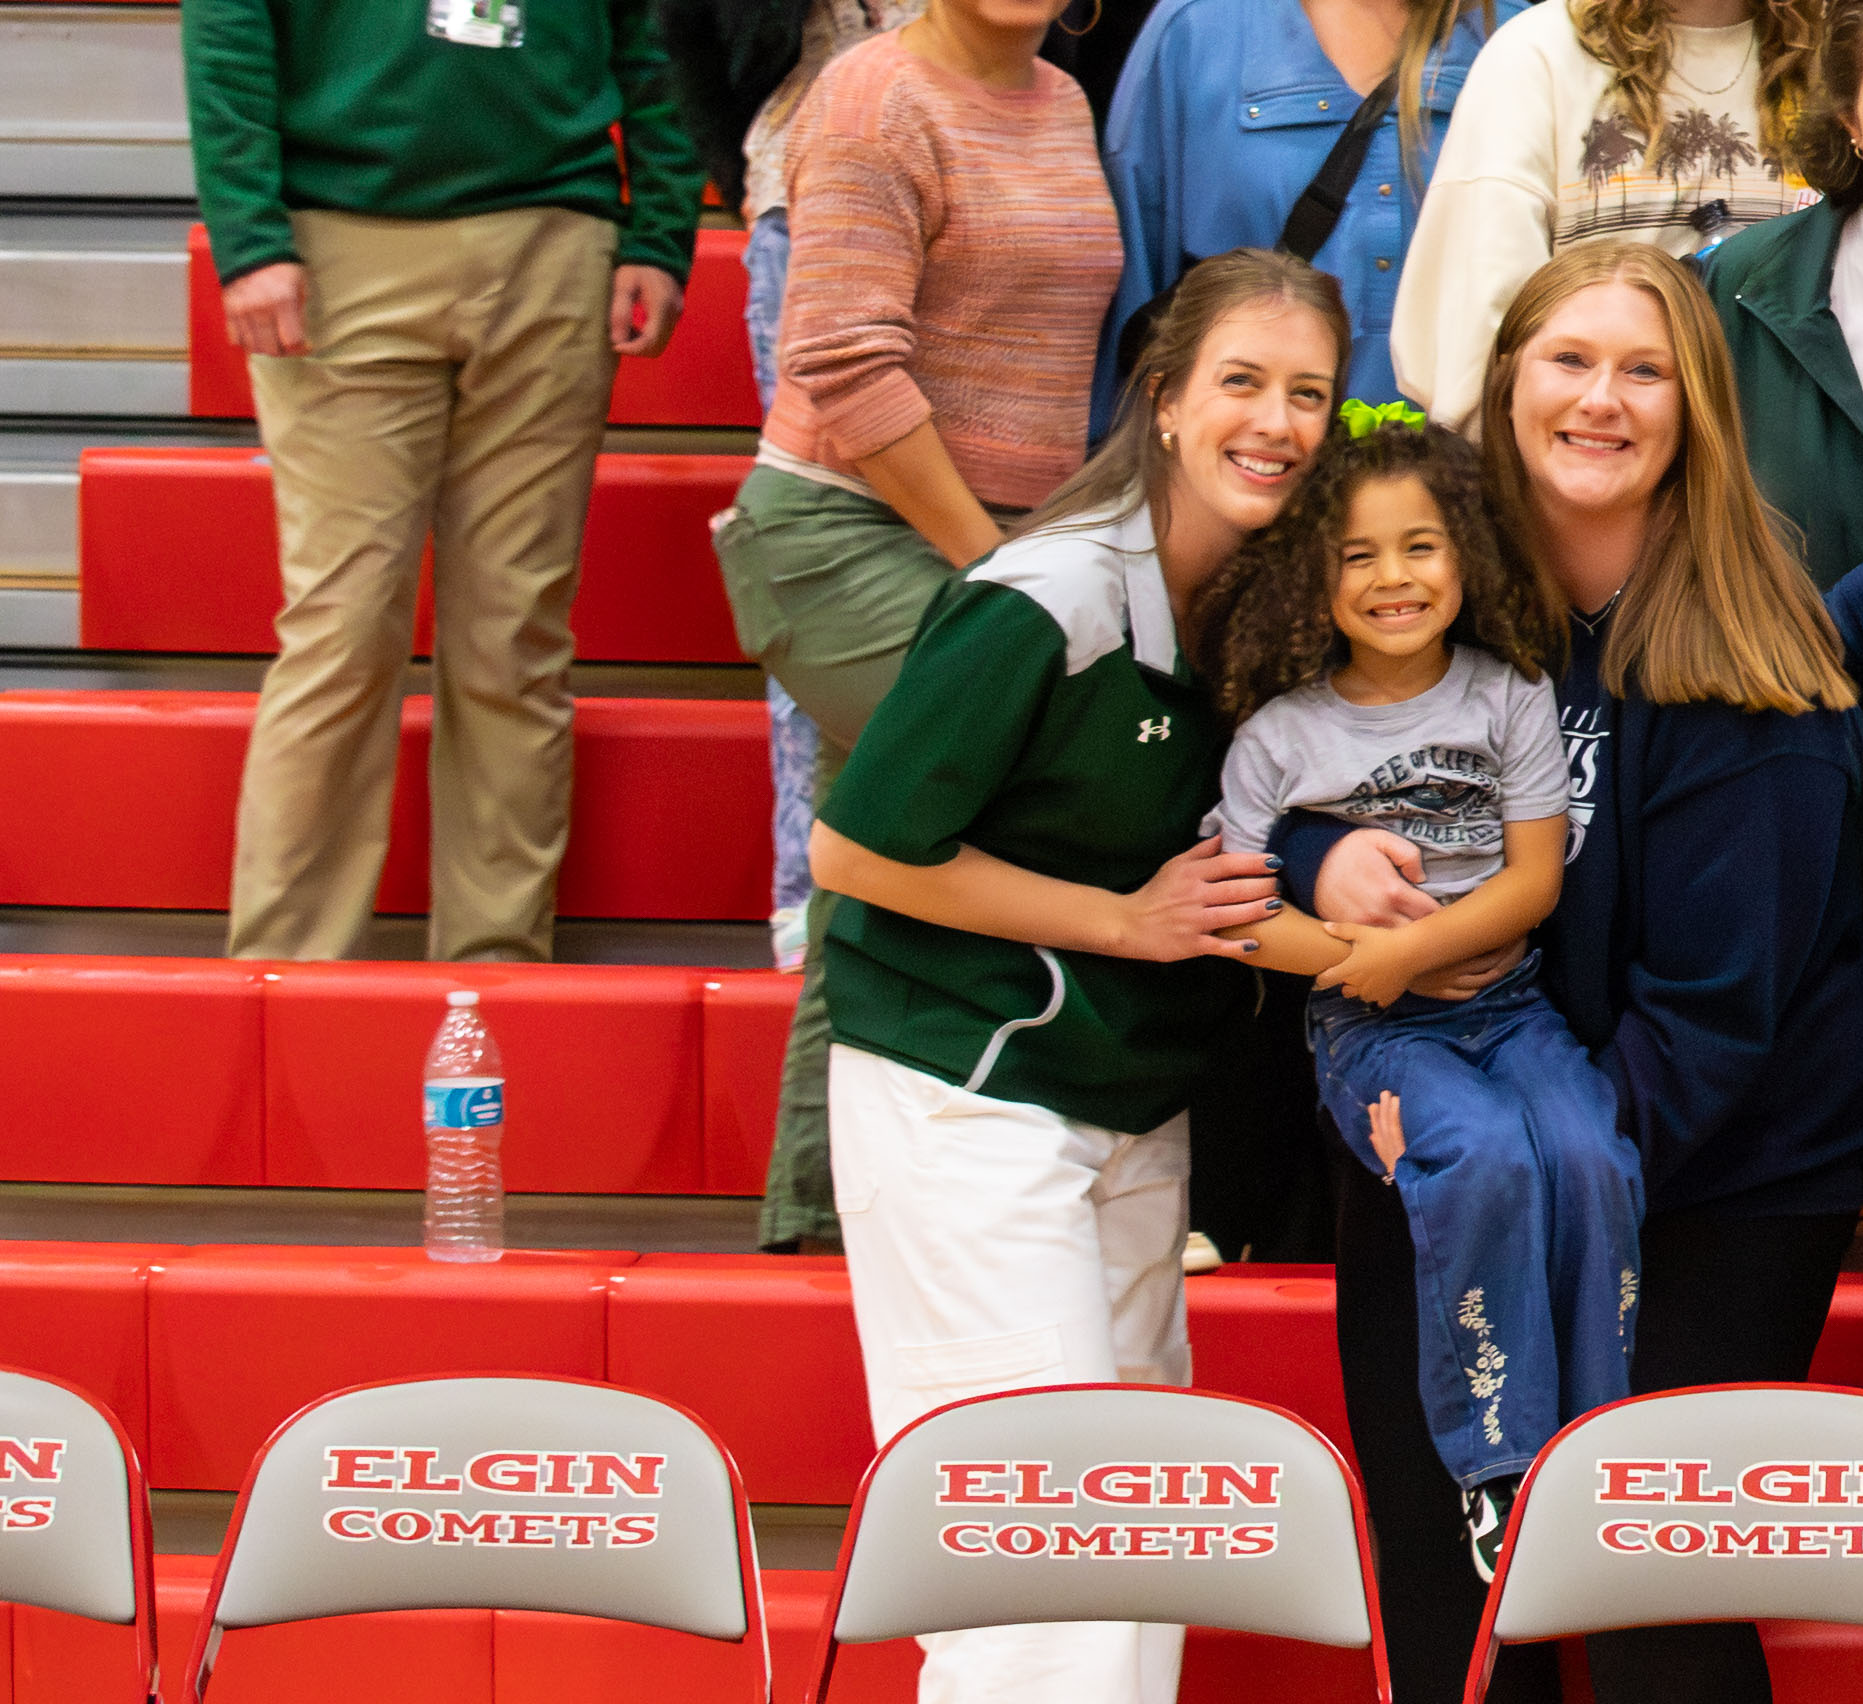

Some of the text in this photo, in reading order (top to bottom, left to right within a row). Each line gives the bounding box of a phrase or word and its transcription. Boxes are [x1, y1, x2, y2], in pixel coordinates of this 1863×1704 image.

[1351, 754, 1410, 796] REE
[322, 1447, 668, 1498] ELGIN
[935, 1458, 1283, 1508] ELGIN
[322, 1506, 658, 1549] COMETS
[938, 1521, 1278, 1560] COMETS
